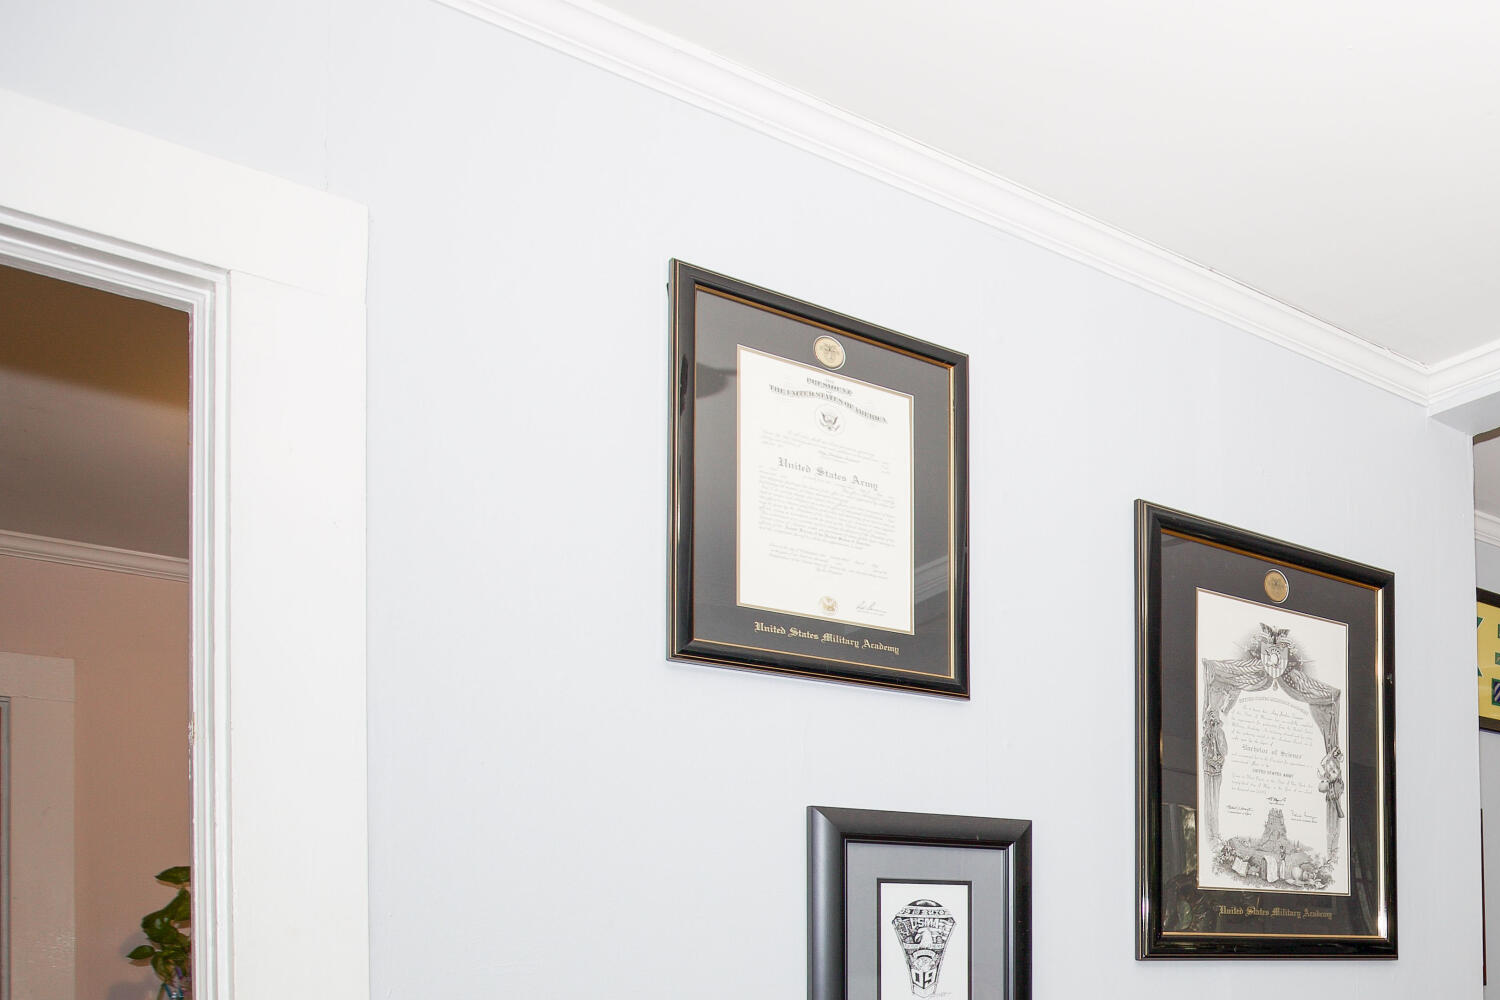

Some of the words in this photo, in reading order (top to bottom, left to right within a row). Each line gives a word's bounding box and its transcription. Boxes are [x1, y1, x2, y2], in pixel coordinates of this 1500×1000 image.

[778, 456, 811, 473] United
[816, 465, 847, 482] States
[850, 474, 879, 491] Army
[754, 621, 786, 637] United
[788, 625, 819, 642] States
[821, 631, 859, 648] Military
[862, 637, 900, 655] Academy
[1218, 904, 1244, 918] United
[1246, 904, 1270, 918] States
[1271, 906, 1302, 920] Military
[1303, 908, 1333, 921] Academy
